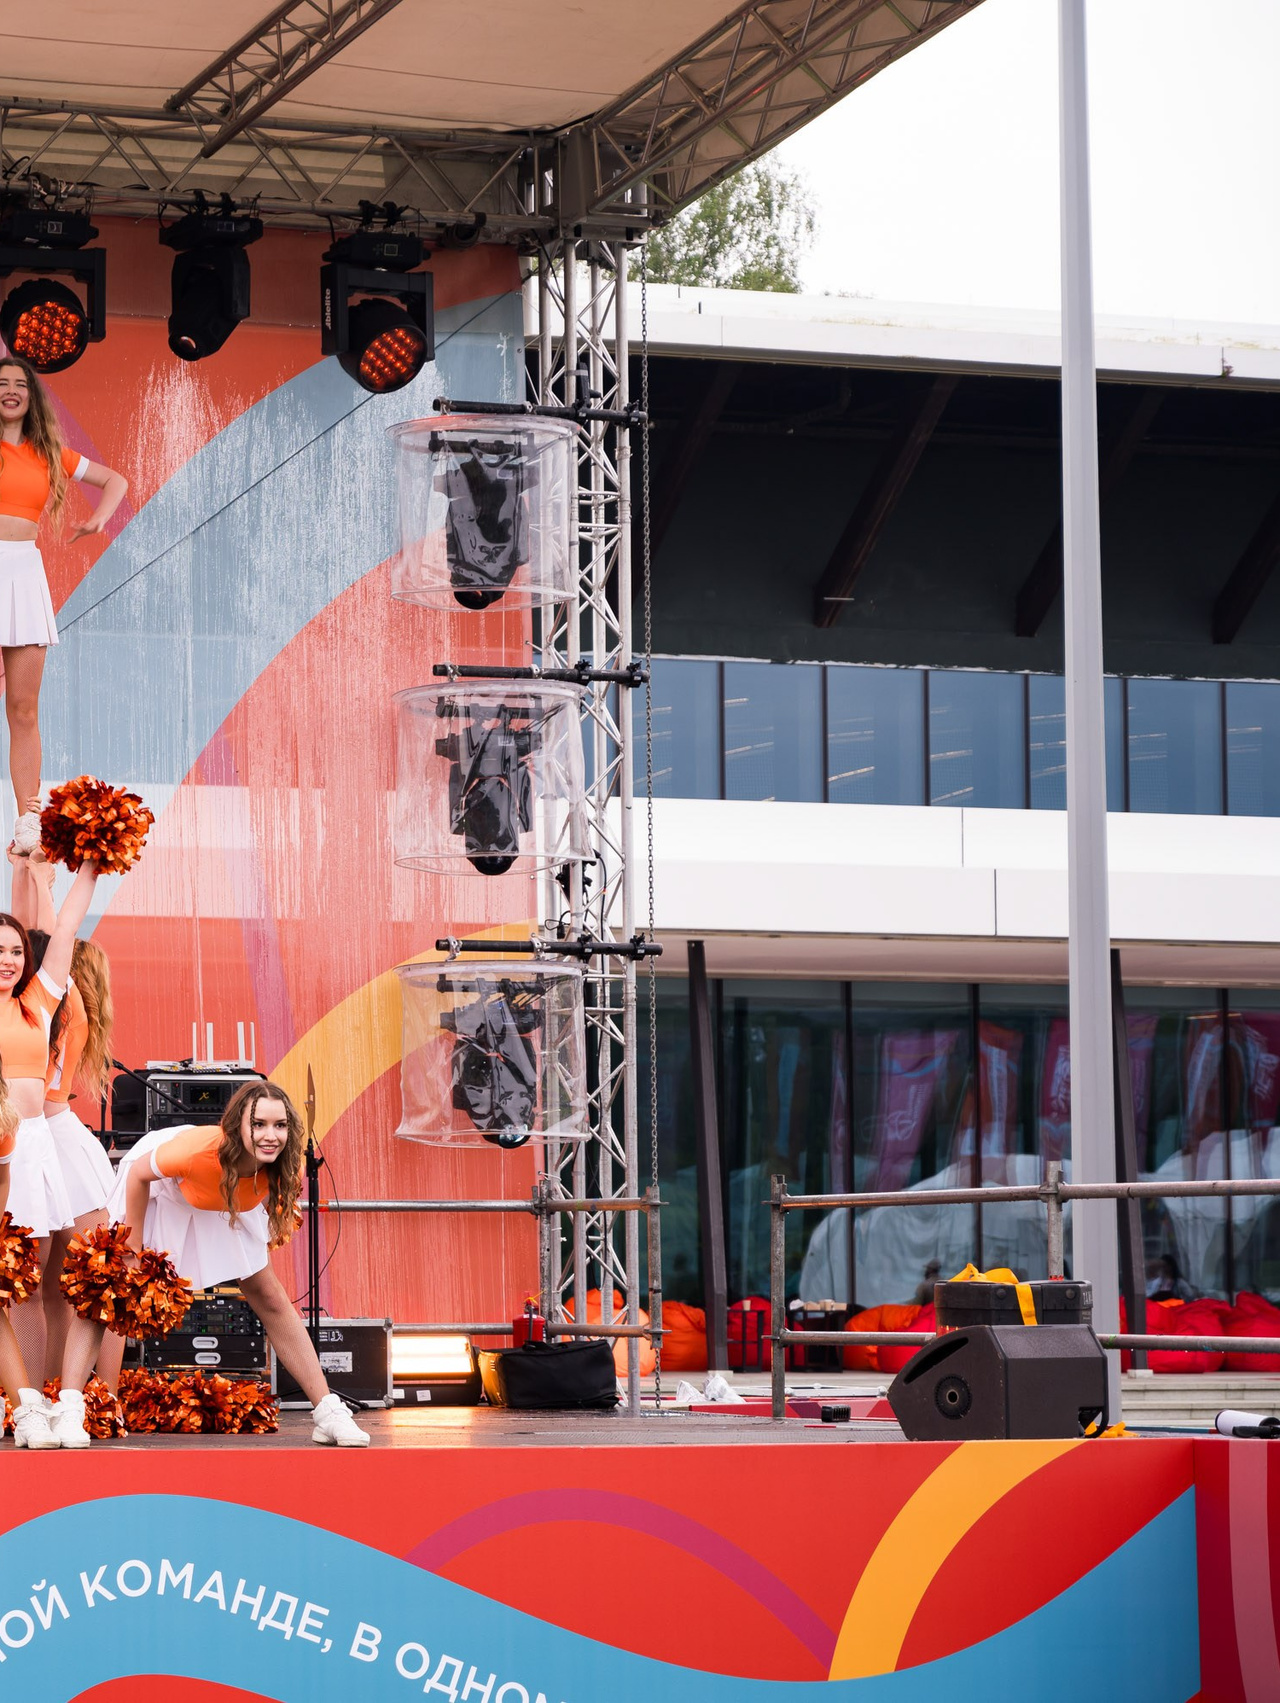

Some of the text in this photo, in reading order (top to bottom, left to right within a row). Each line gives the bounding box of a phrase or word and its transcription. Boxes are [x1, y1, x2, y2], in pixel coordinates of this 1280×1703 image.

[324, 287, 332, 331] Ablelite
[79, 1558, 333, 1653] КОМАНДЕ,
[349, 1621, 382, 1662] В
[395, 1641, 568, 1703] ОДНО
